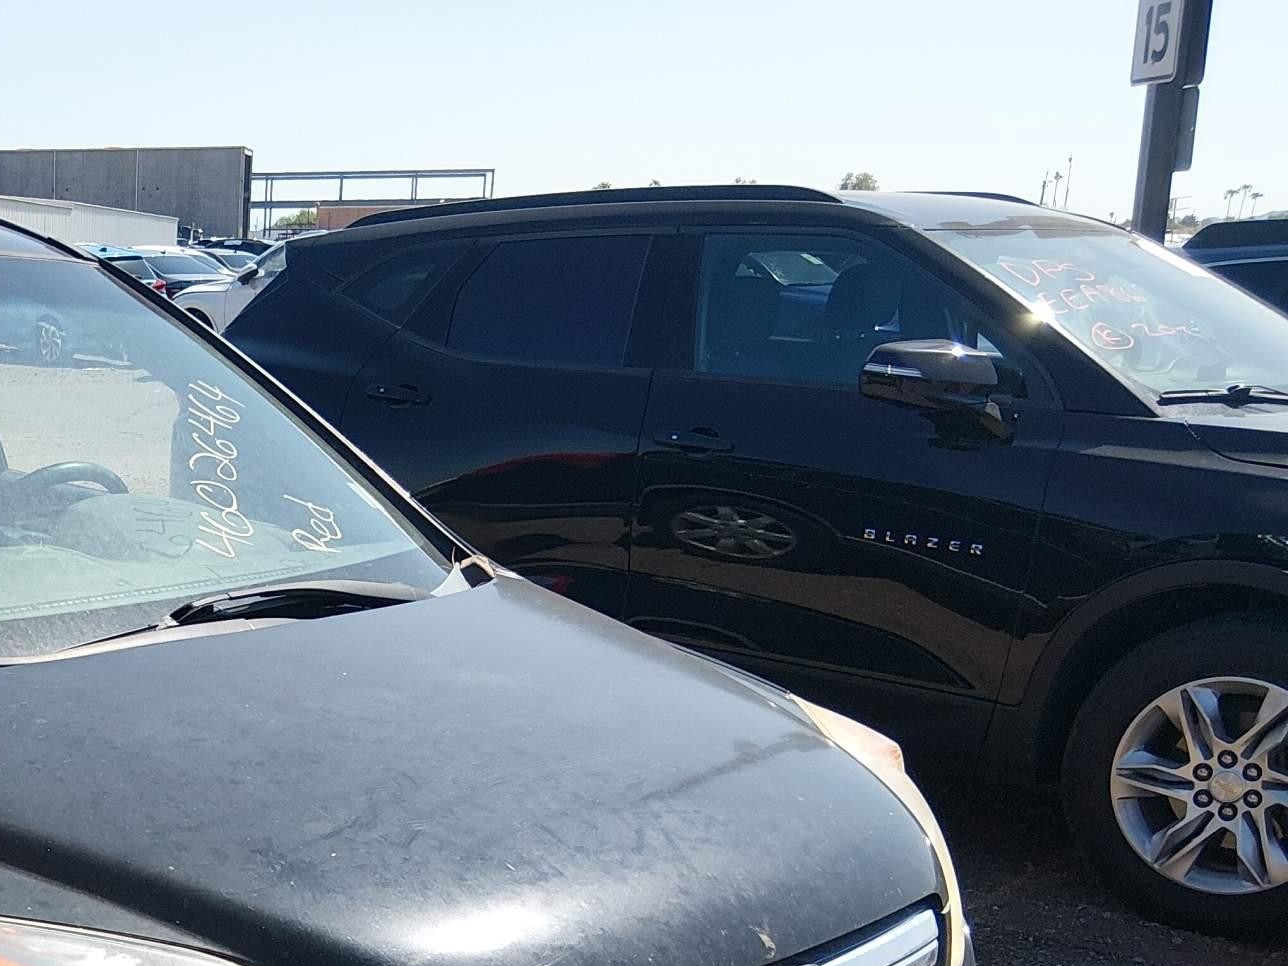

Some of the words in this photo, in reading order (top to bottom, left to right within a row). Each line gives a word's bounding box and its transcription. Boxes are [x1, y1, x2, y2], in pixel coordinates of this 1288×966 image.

[1142, 1, 1173, 65] 15
[187, 380, 254, 558] 46026464
[283, 494, 343, 553] Red
[863, 528, 984, 556] BLAZER
